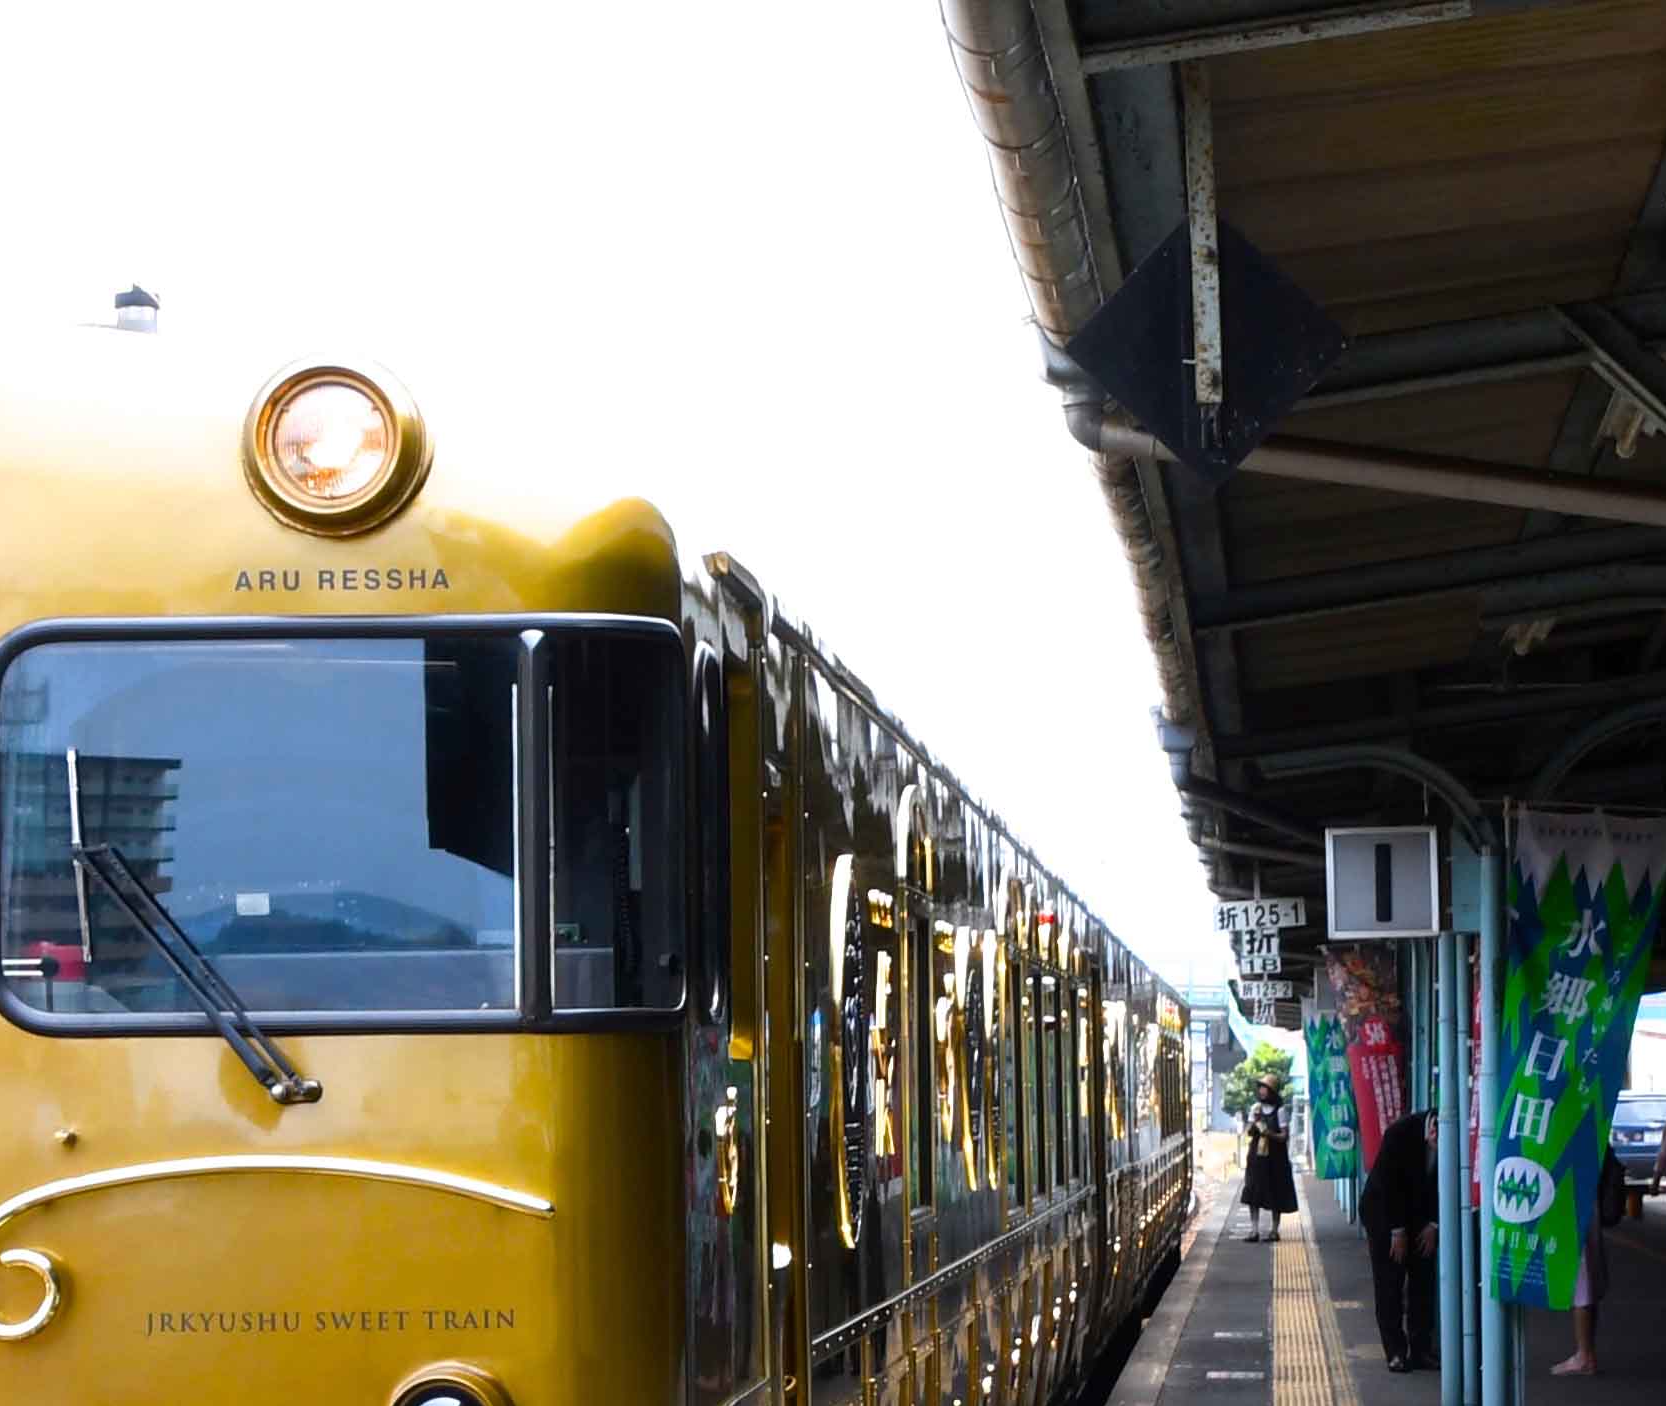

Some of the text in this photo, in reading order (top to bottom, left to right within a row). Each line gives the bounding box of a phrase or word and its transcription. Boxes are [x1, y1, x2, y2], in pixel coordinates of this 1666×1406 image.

[234, 568, 451, 592] ARU RESSHA
[1218, 901, 1300, 930] 折125-1
[1507, 908, 1607, 1146] 水郷日田
[145, 1308, 516, 1337] JRKYUSHU SWEET TRAIN
